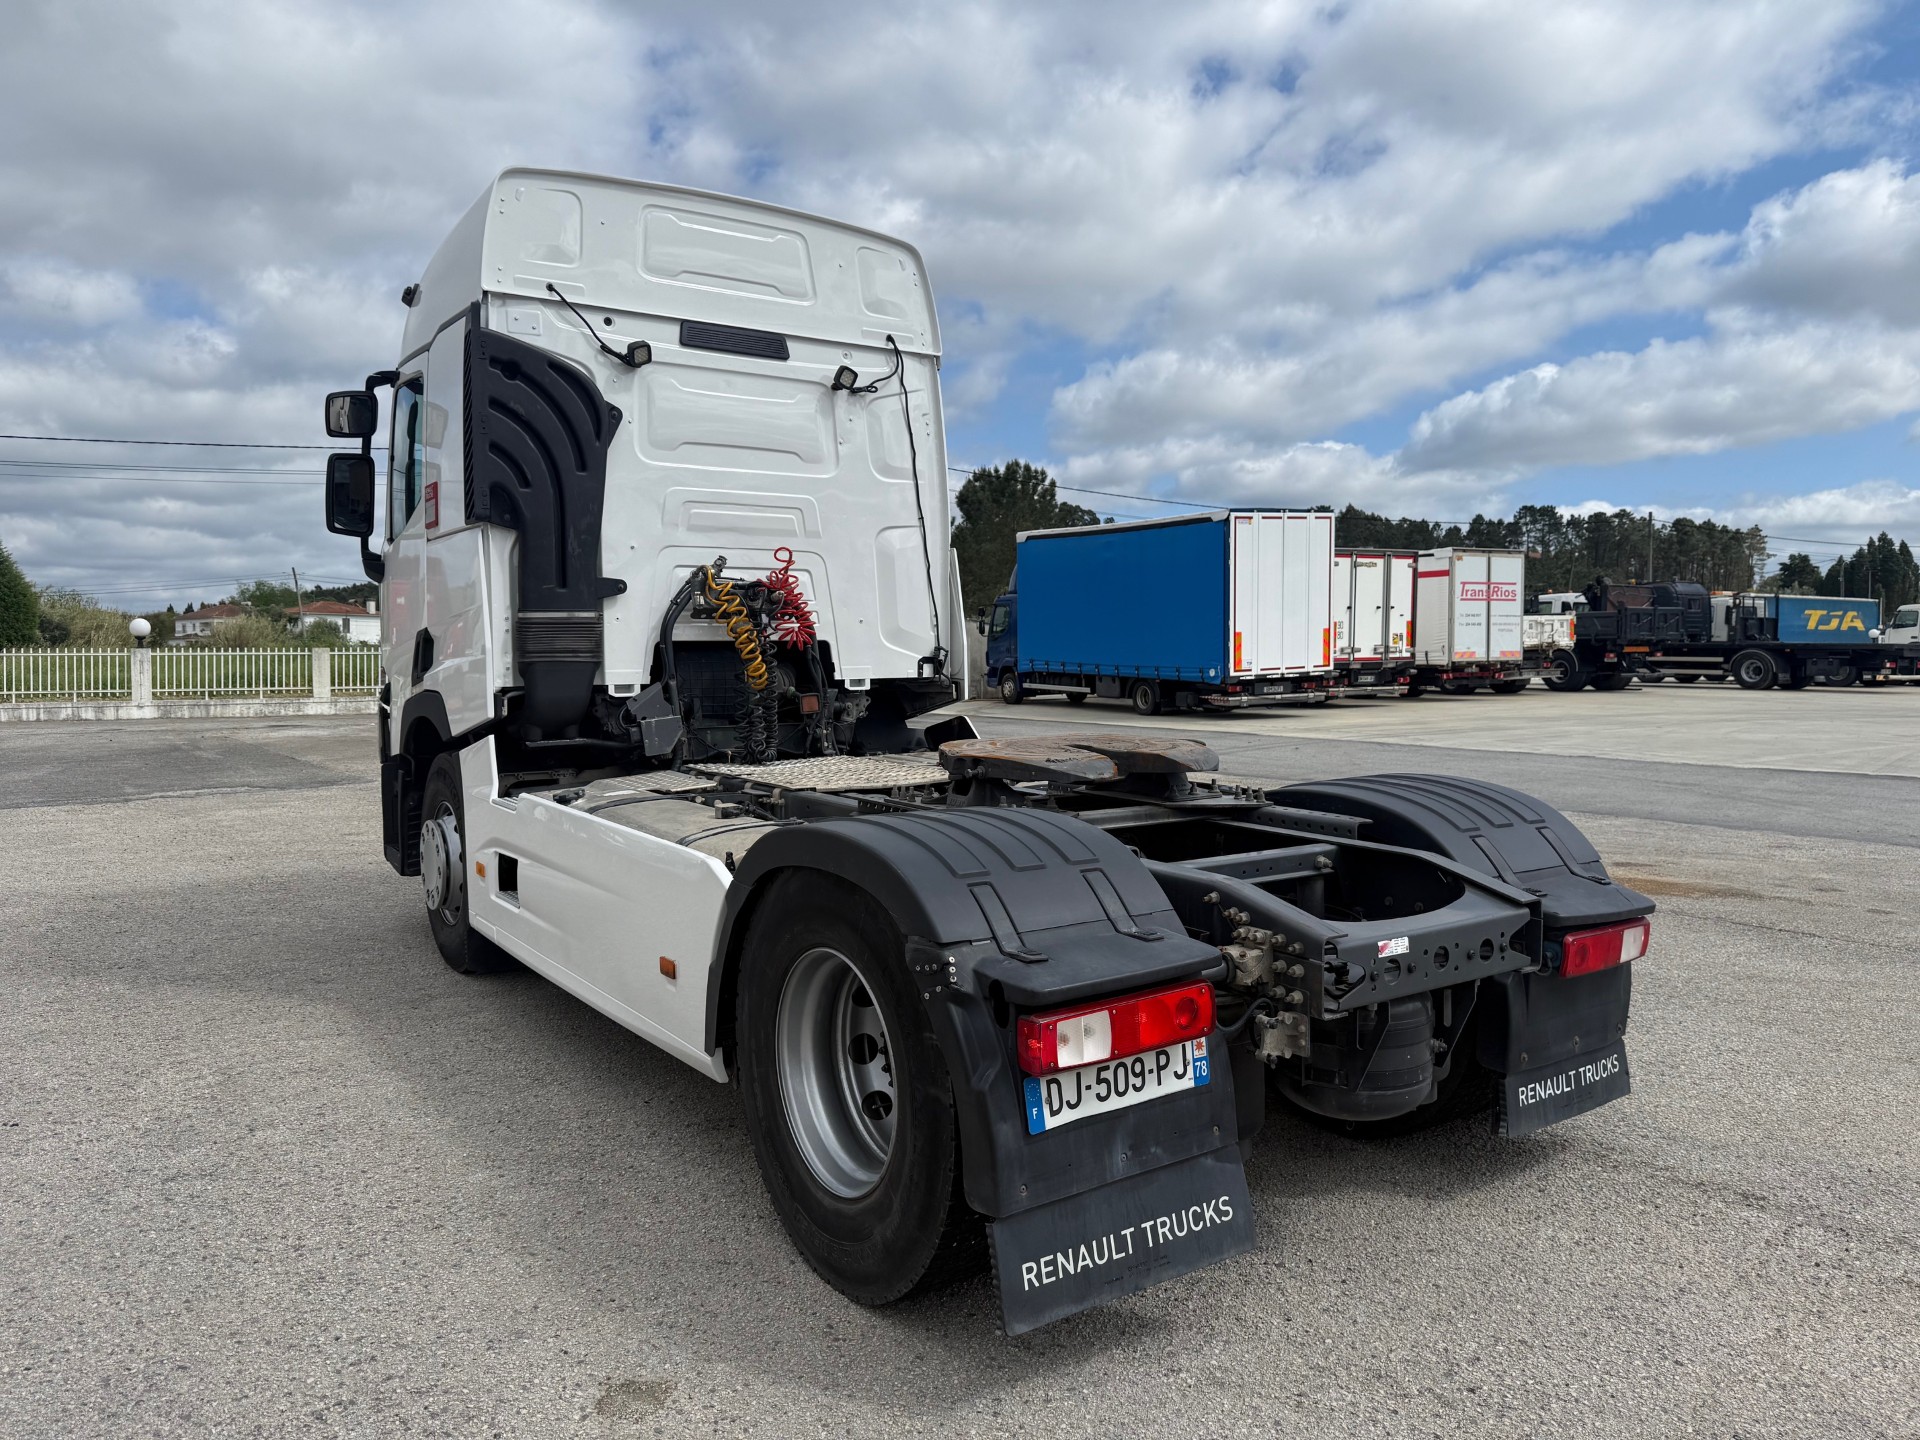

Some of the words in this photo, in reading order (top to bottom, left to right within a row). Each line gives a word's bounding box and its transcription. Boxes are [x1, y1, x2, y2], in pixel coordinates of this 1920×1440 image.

[1804, 609, 1866, 631] TJA
[1045, 1043, 1190, 1118] DJ-509-PJ
[1194, 1060, 1208, 1077] 78
[1519, 1070, 1576, 1107] RENAULT
[1578, 1053, 1620, 1086] TRUCKS
[1032, 1107, 1038, 1120] F
[1021, 1227, 1135, 1291] RENAULT
[1140, 1195, 1233, 1248] TRUCKS
